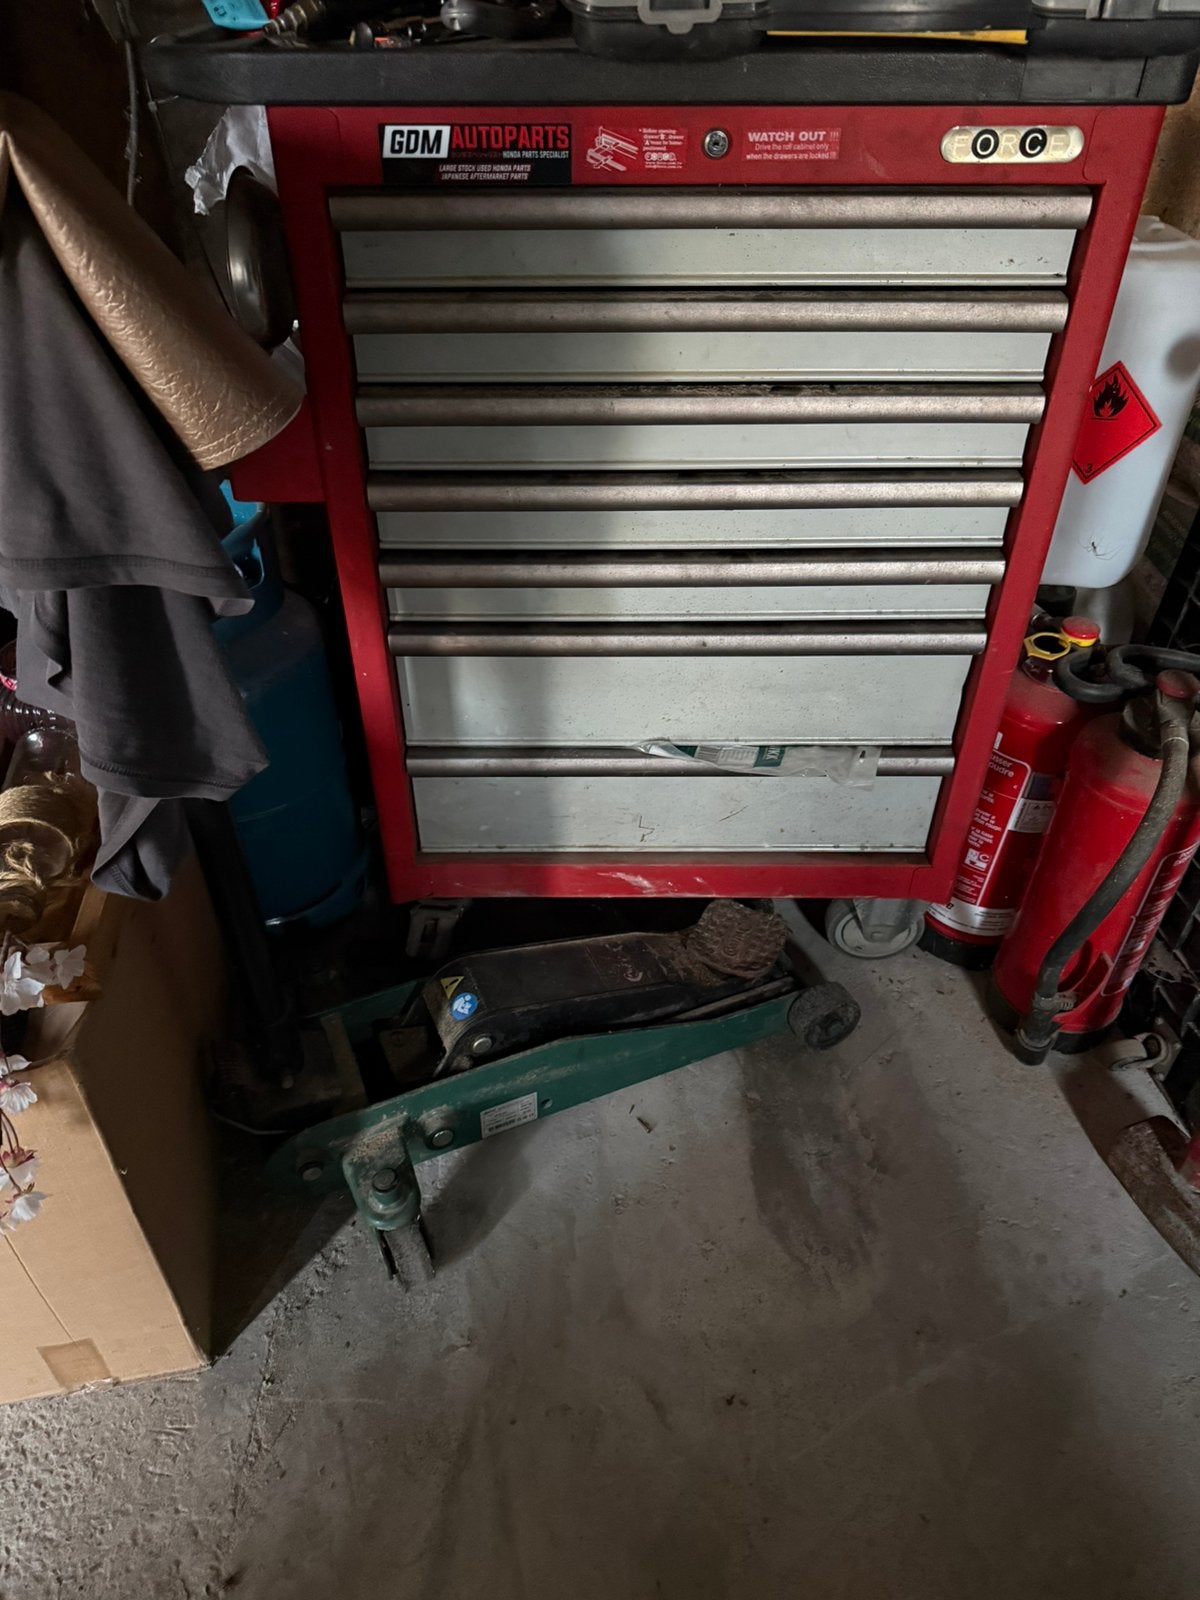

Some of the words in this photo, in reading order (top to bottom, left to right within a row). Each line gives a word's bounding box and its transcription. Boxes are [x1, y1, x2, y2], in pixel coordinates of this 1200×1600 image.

[390, 129, 443, 154] GDM
[452, 126, 569, 149] AUTOPARTS
[747, 131, 795, 142] WATCH
[798, 131, 826, 142] OUT
[755, 143, 771, 151] Drive
[793, 143, 815, 151] cabinet
[816, 143, 829, 151] only
[951, 129, 1069, 157] FORCE
[503, 150, 521, 159] HONDA
[522, 150, 538, 159] PARTS
[539, 150, 569, 159] SPECIALIST
[773, 152, 797, 160] drawers
[439, 164, 457, 172] LARGE
[458, 164, 476, 172] STOCK
[476, 164, 492, 172] USED
[492, 164, 512, 172] HONDA
[513, 164, 531, 172] PARTS
[441, 172, 469, 180] JAPANESE
[470, 172, 510, 180] AFTERMARKET
[511, 172, 528, 180] PARTS
[1085, 463, 1093, 474] 3
[988, 761, 1015, 778] oudre
